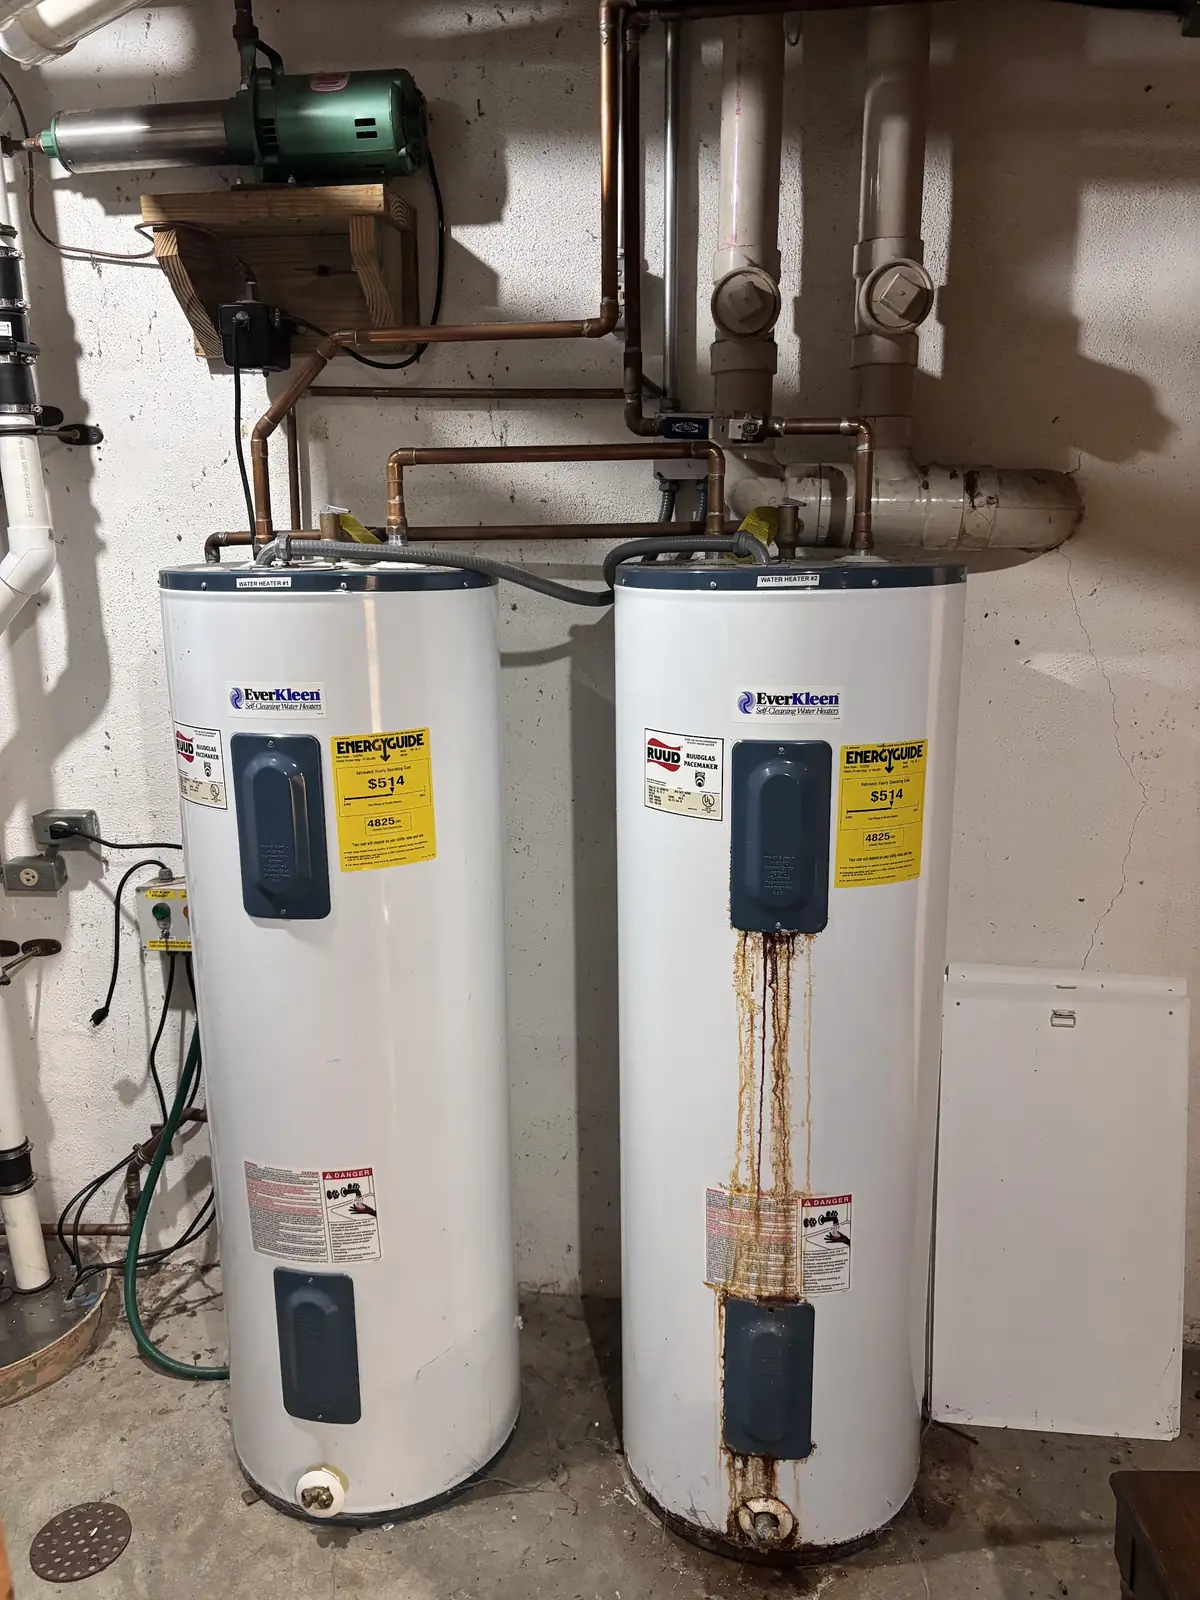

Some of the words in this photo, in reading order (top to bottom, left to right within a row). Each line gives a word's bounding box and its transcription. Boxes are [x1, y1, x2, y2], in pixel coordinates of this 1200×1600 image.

[238, 580, 258, 588] WATER
[244, 687, 321, 701] EverKleen
[756, 691, 839, 705] EverKleen
[244, 702, 281, 711] Self-Cleaning
[280, 702, 298, 710] Water
[298, 702, 322, 710] Heaters
[755, 707, 796, 716] Self-Cleaning
[797, 707, 816, 715] Water
[816, 707, 839, 715] Heaters
[647, 747, 680, 764] RUUD
[686, 752, 715, 762] RUUDGLAS
[684, 761, 719, 770] PACEMAKER
[368, 775, 405, 790] $514
[871, 788, 903, 803] $514
[367, 817, 395, 828] 4825
[865, 831, 890, 843] 4825
[334, 1169, 370, 1179] DANGER
[813, 1196, 849, 1206] DANGER
